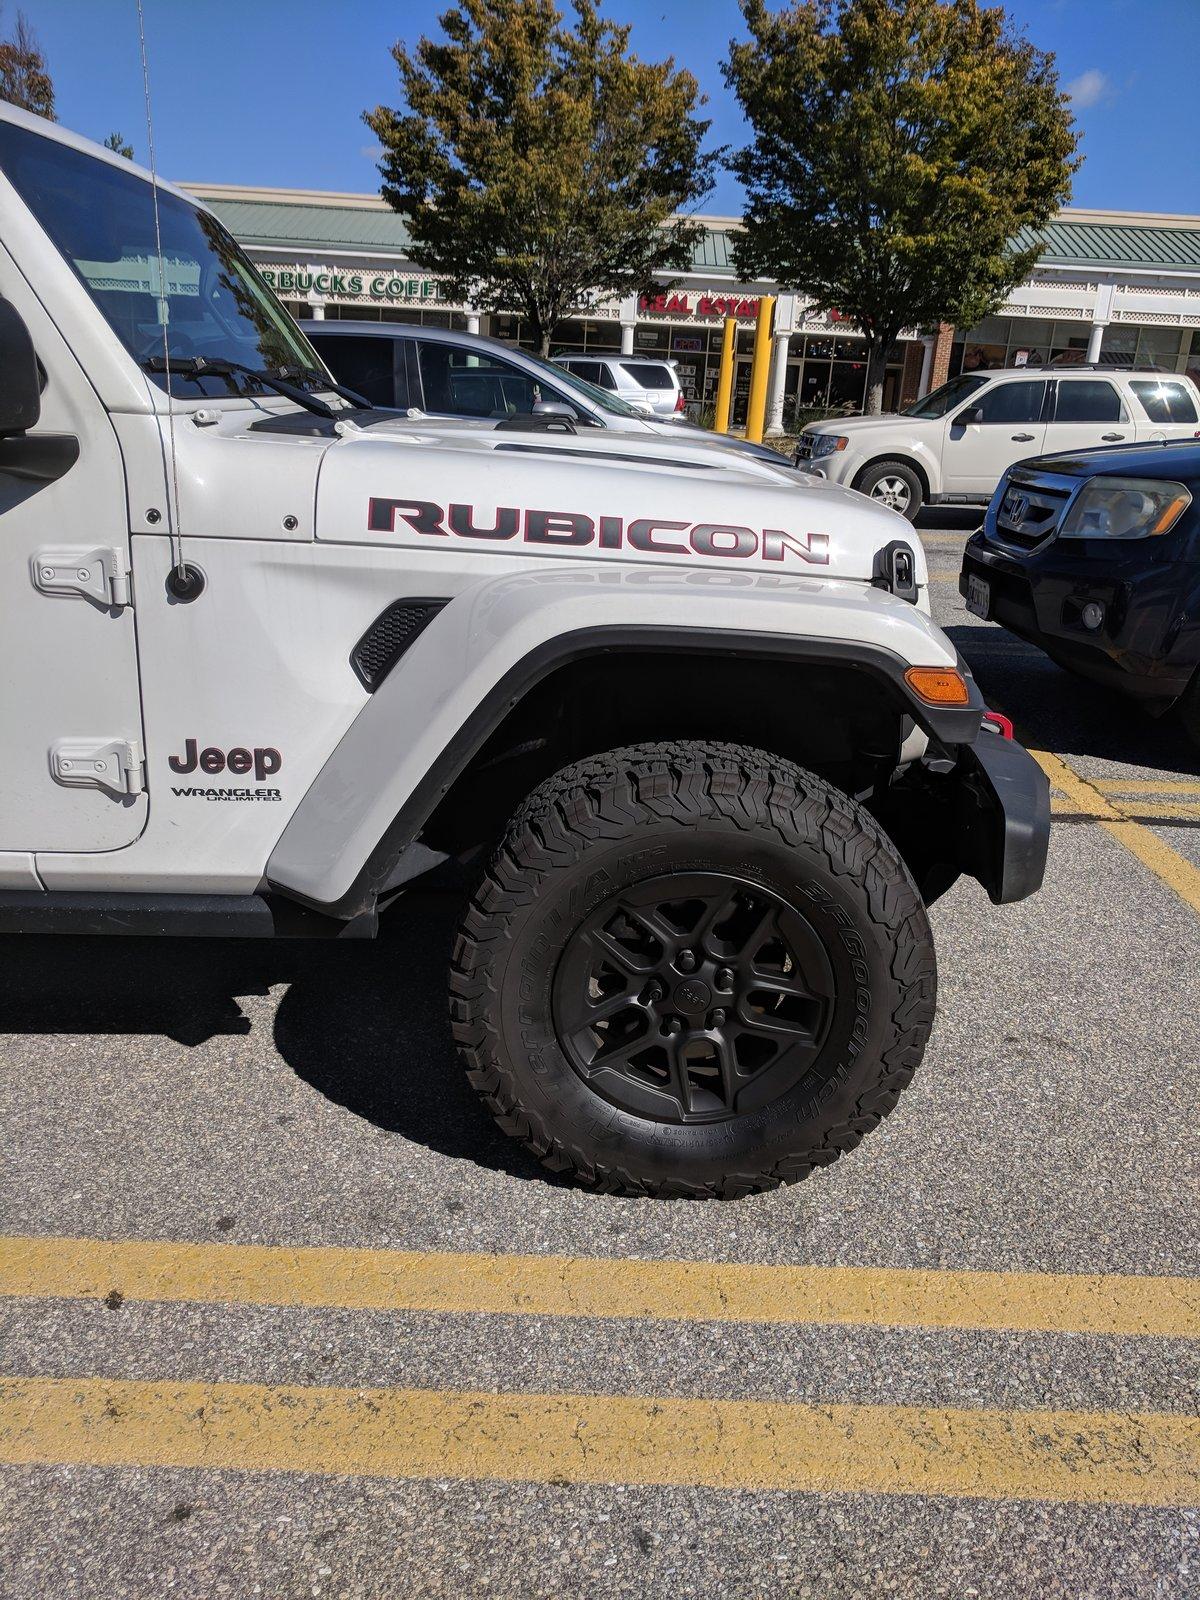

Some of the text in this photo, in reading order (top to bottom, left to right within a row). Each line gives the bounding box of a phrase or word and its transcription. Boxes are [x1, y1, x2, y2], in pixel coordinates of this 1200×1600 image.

[367, 497, 830, 565] RUBICON
[168, 738, 282, 781] Jeep
[170, 787, 281, 797] WRANGLER
